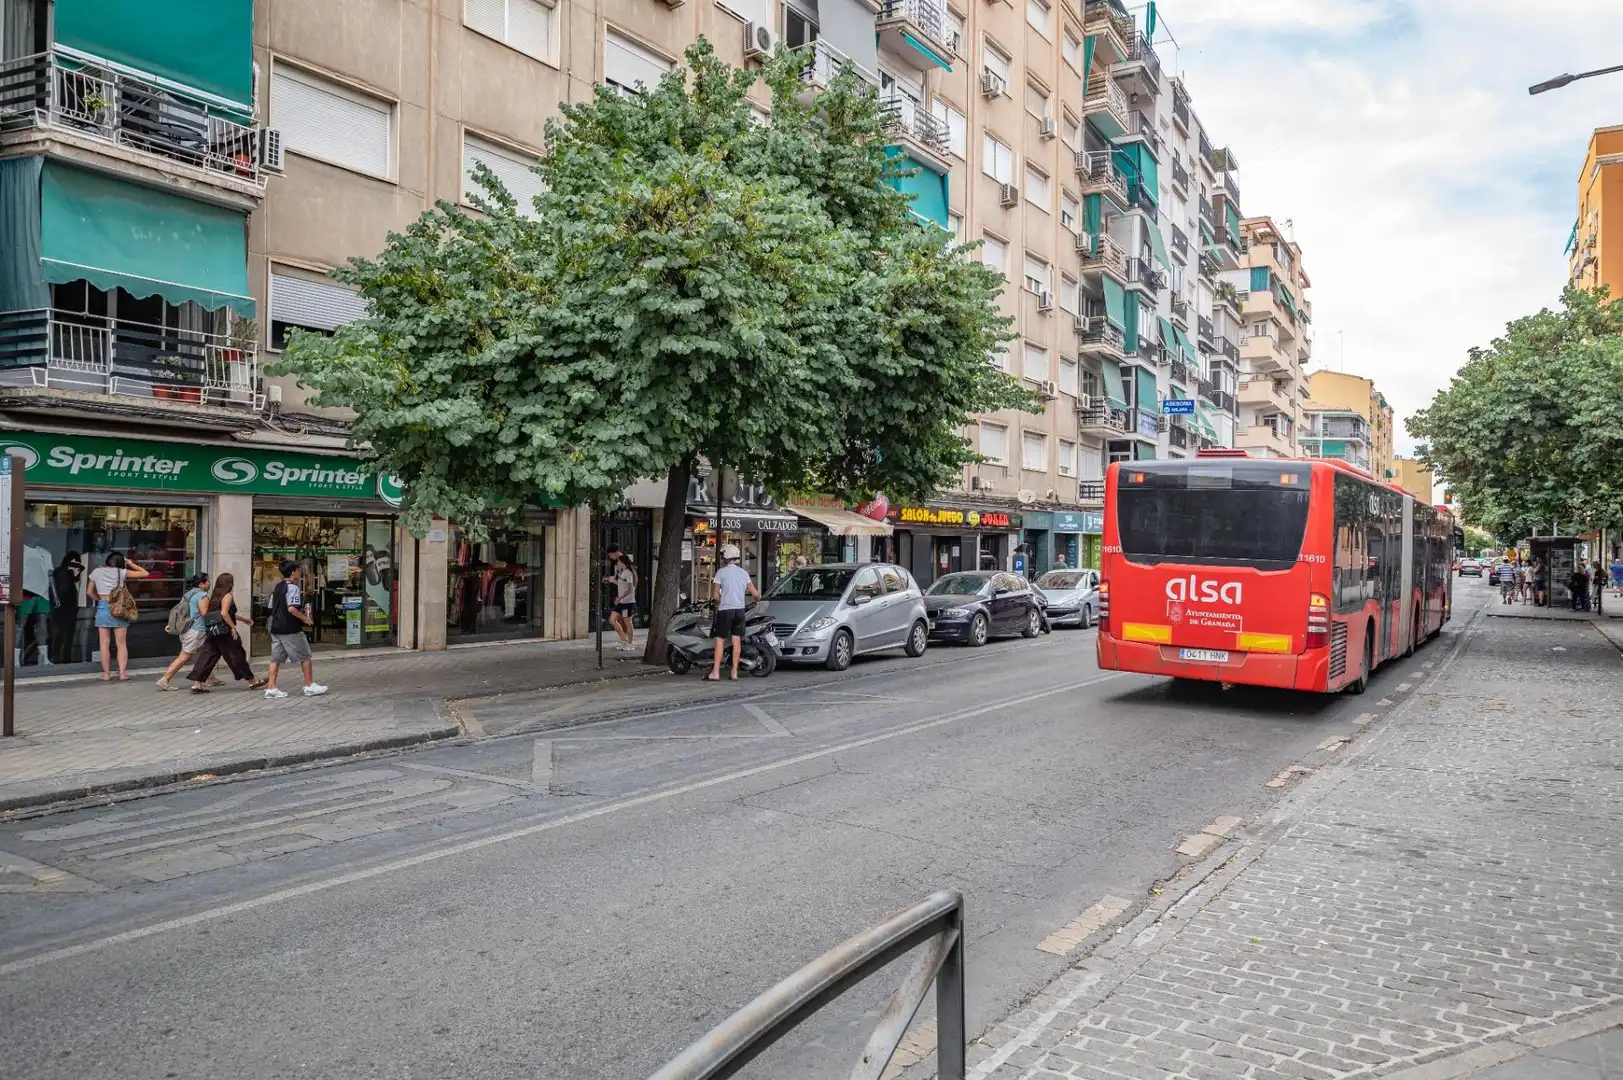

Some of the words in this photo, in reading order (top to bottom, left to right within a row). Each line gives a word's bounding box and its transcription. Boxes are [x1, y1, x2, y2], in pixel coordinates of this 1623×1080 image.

[47, 446, 188, 474] Sprinter
[263, 461, 370, 486] Sprinter
[937, 509, 963, 523] JUEGO
[981, 513, 1009, 526] JOKER
[758, 520, 798, 530] CALZADOS
[1299, 554, 1326, 564] 11610
[1166, 574, 1242, 605] alsa
[1186, 650, 1207, 659] 0411
[1210, 652, 1227, 660] HNK
[17, 769, 517, 883] BUS
